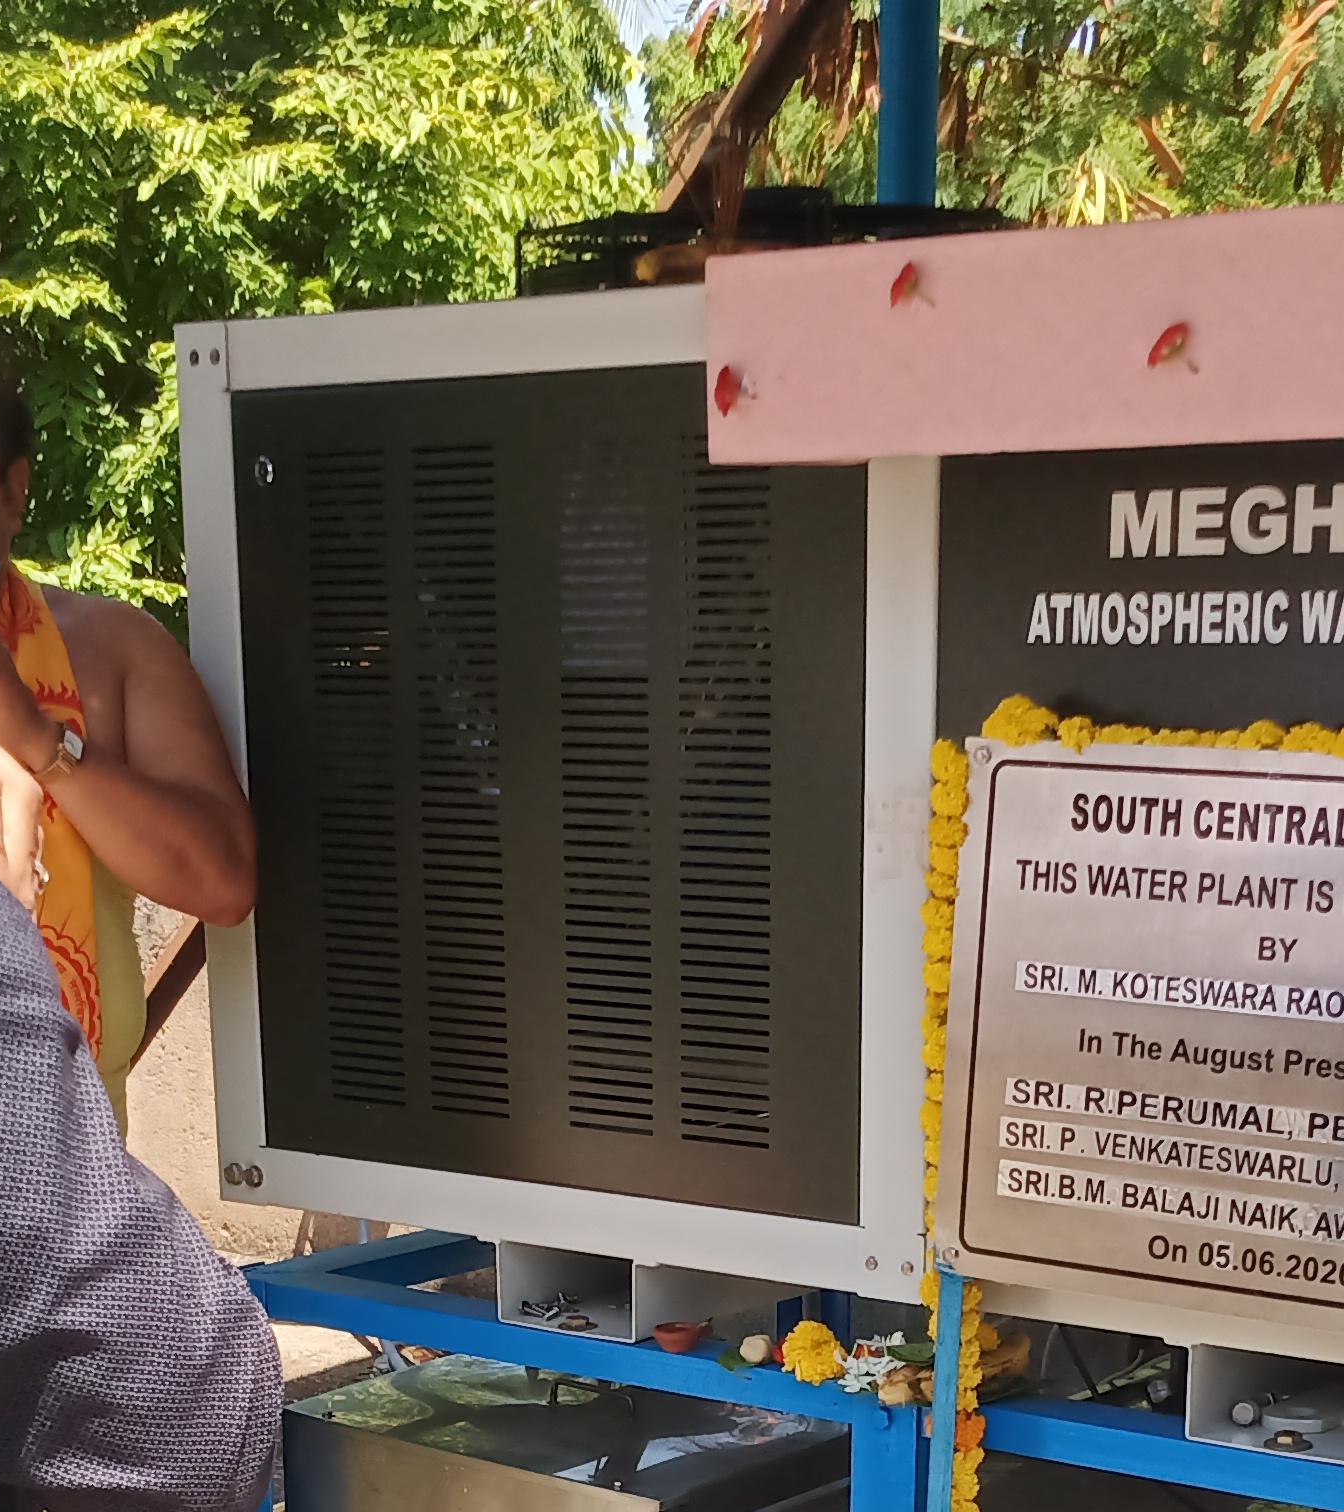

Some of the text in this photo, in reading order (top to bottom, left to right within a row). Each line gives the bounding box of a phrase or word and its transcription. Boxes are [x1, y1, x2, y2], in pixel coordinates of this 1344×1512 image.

[1027, 590, 1289, 645] ATMOSPHERIC
[1071, 793, 1183, 837] SOUTH
[1016, 859, 1077, 894] THIS
[1087, 864, 1188, 903] WATER
[1197, 872, 1299, 910] PLANT
[1306, 880, 1334, 913] IS
[1258, 936, 1299, 963] BY
[1023, 963, 1069, 993] SRI.
[1077, 968, 1103, 996] M.
[1112, 971, 1277, 1012] KOTESWARA
[1078, 1028, 1102, 1054] In
[1112, 1031, 1162, 1060] The
[1169, 1038, 1274, 1074] August
[1011, 1079, 1071, 1110] SRI.
[1083, 1086, 1294, 1141] R.PERUMAL,
[1005, 1121, 1051, 1150] SRI.
[1094, 1131, 1340, 1193] VENKATESWARLU,
[1007, 1167, 1111, 1205] SRI.B.M.
[1121, 1183, 1219, 1221] BALAJI
[1228, 1199, 1304, 1238] NAIK,
[1147, 1235, 1188, 1263] On
